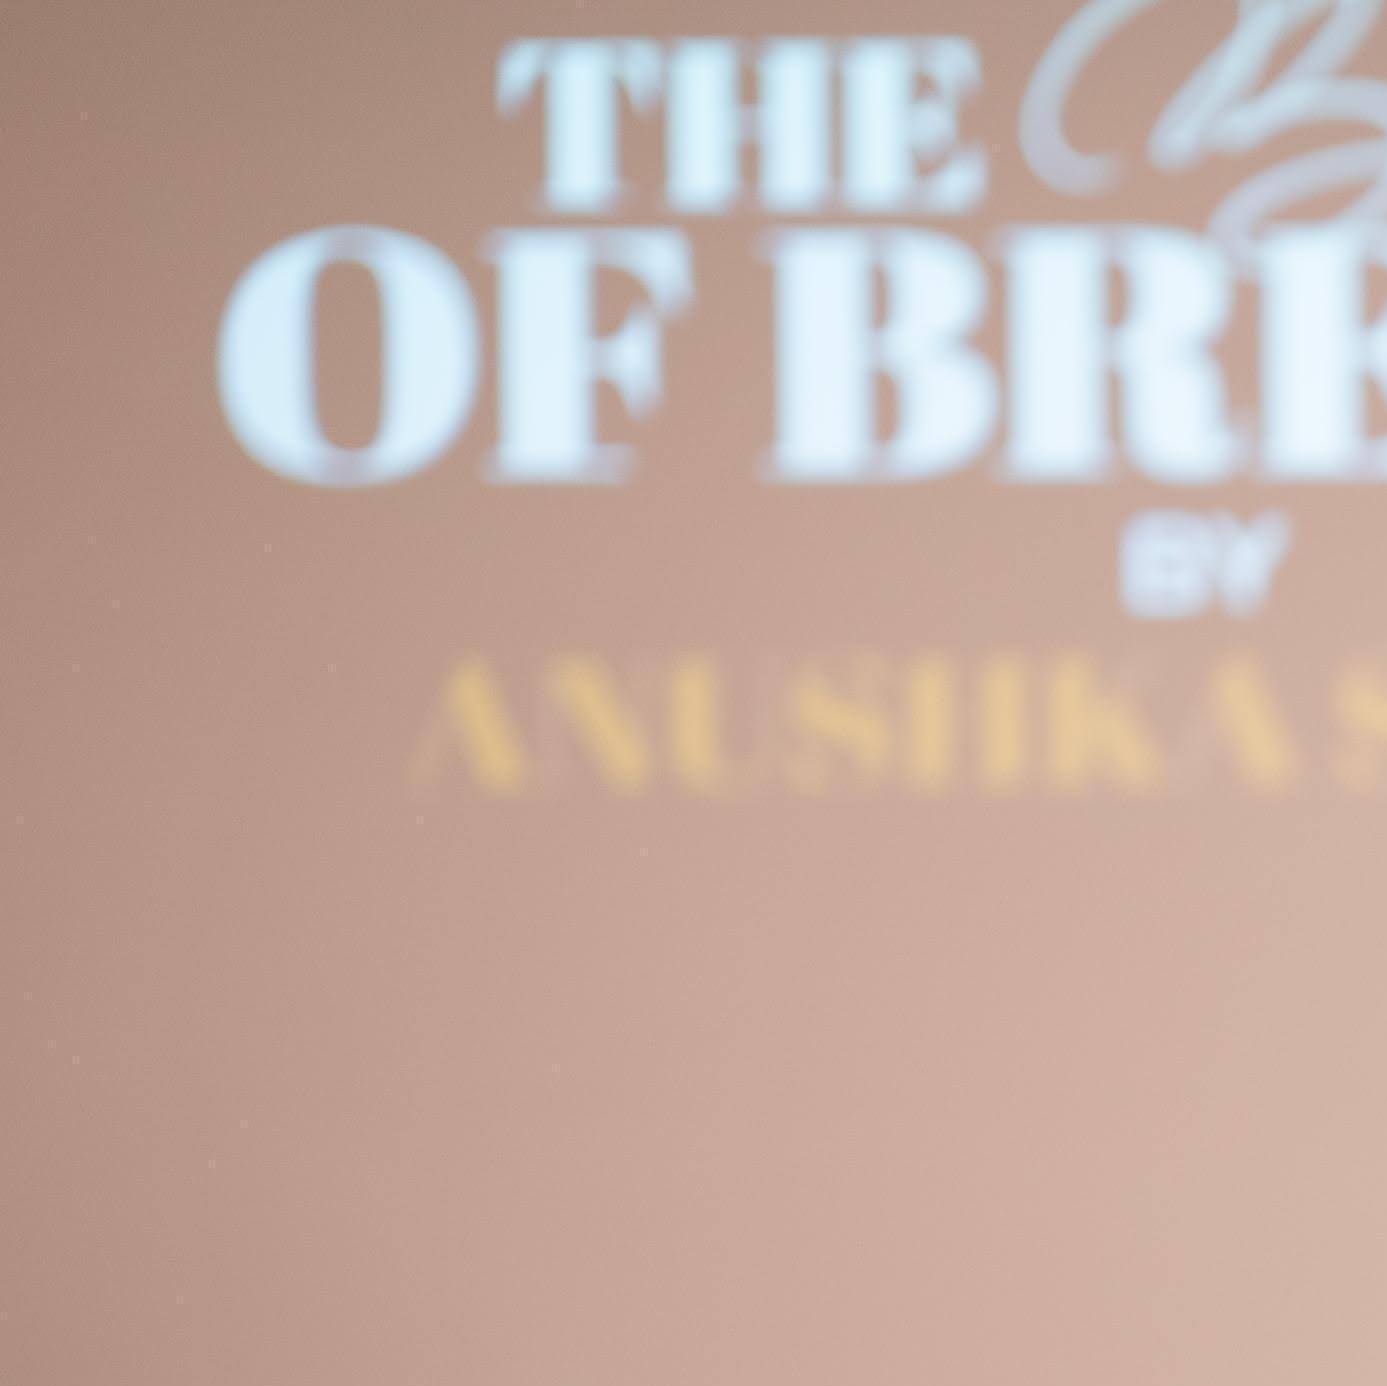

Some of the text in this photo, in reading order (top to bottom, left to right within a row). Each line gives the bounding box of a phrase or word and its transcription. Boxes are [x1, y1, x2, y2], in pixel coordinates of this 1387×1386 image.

[498, 34, 988, 215] THE
[215, 222, 692, 488] OF
[1118, 510, 1292, 620] BY
[415, 647, 1302, 798] ANUSHKA
